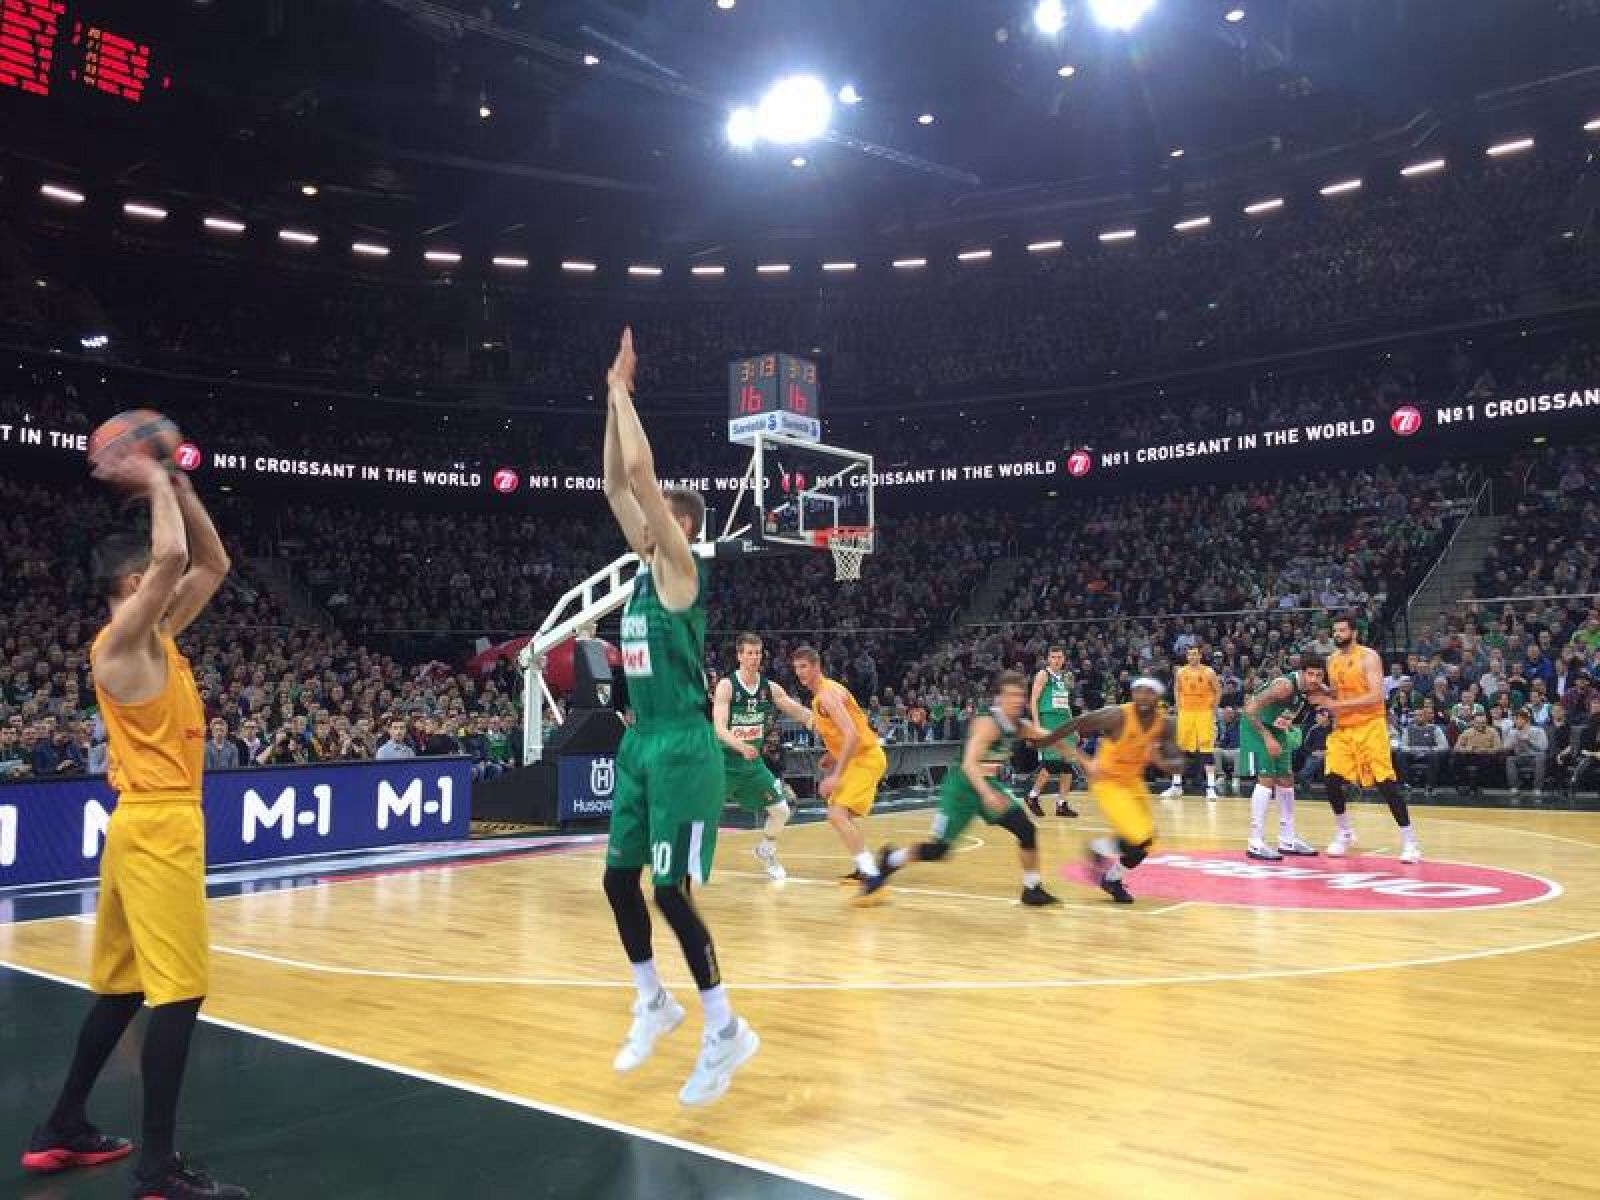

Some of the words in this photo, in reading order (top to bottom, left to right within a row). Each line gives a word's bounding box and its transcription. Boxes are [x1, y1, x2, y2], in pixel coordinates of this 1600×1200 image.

[20, 428, 41, 444] IN
[50, 431, 87, 450] THE
[1136, 437, 1232, 463] CROISSANT
[1237, 434, 1257, 450] IN
[1263, 427, 1299, 446] THE
[1305, 418, 1375, 440] WORLD
[255, 457, 356, 478] CROISSANT
[361, 465, 379, 480] IN
[385, 467, 417, 483] THE
[422, 470, 481, 487] WORLD
[850, 469, 935, 488] CROISSANT
[941, 467, 957, 481] IN
[962, 464, 993, 480] THE
[998, 459, 1057, 477] WORLD
[243, 786, 332, 842] M-1
[377, 776, 452, 830] M-1
[652, 841, 672, 876] 10
